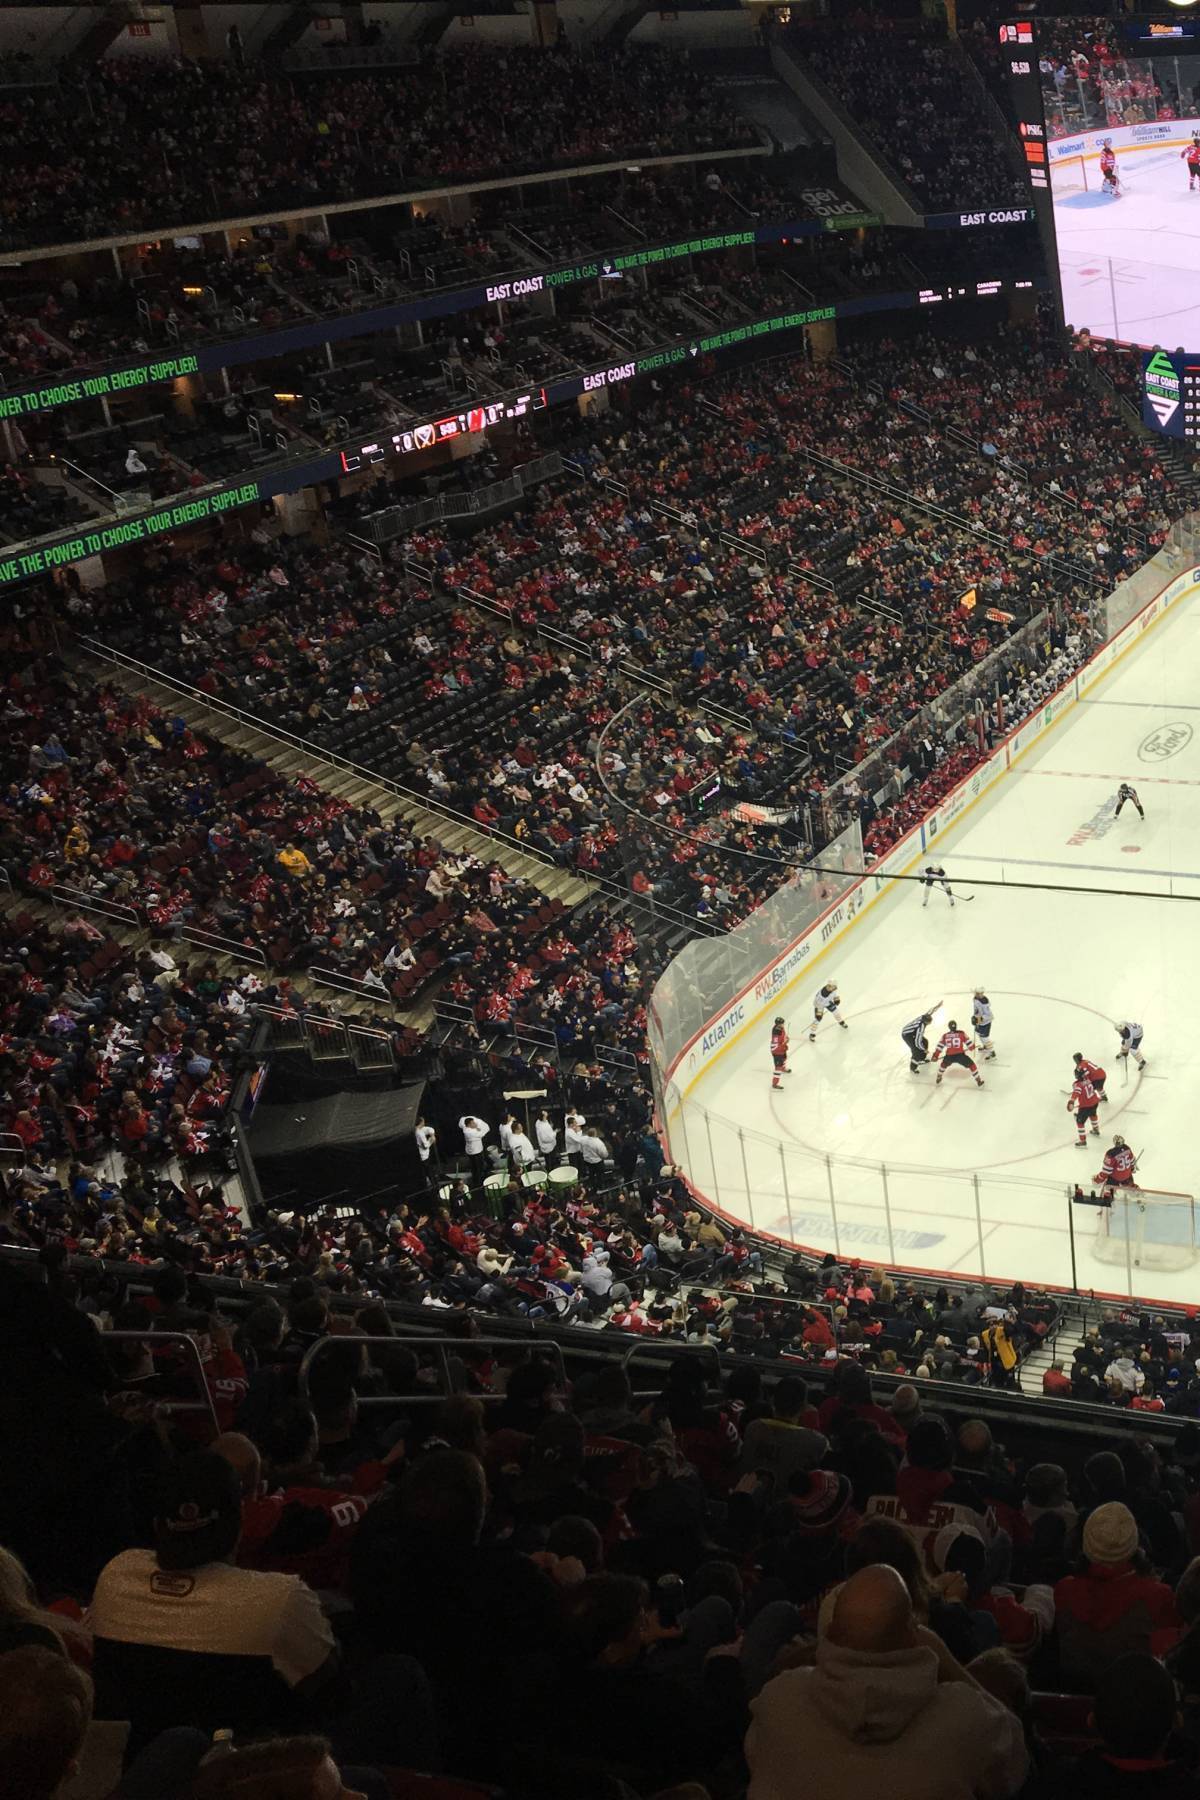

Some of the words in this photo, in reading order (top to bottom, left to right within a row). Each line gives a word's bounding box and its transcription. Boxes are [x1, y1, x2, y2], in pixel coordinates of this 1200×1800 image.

[1058, 143, 1085, 155] Walmart
[801, 188, 838, 206] get
[960, 213, 985, 226] EAST
[988, 210, 1028, 224] COAST
[486, 284, 511, 302] EAST
[513, 276, 543, 294] COAST
[546, 270, 574, 286] POWER
[583, 264, 598, 278] GAS
[23, 395, 39, 410] TO
[40, 384, 82, 408] CHOOSE
[82, 376, 110, 398] YOUR
[112, 367, 150, 391] ENERGY
[150, 356, 198, 381] SUPPLIER!
[584, 372, 606, 391] EAST
[608, 363, 636, 382] COAST
[638, 354, 665, 372] POWER
[672, 348, 686, 362] GAS
[1146, 372, 1160, 385] EAST
[1160, 376, 1180, 390] COAST
[19, 556, 44, 576] THE
[45, 540, 86, 568] POWER
[85, 536, 100, 552] TO
[103, 523, 144, 549] CHOOSE
[146, 513, 173, 534] YOUR
[174, 501, 211, 524] ENERGY
[211, 482, 259, 508] SUPPLIER!
[1144, 729, 1188, 756] Ford
[754, 943, 810, 1001] RWJBarnabas
[702, 1004, 745, 1056] Atlantic
[1117, 1157, 1132, 1172] 35
